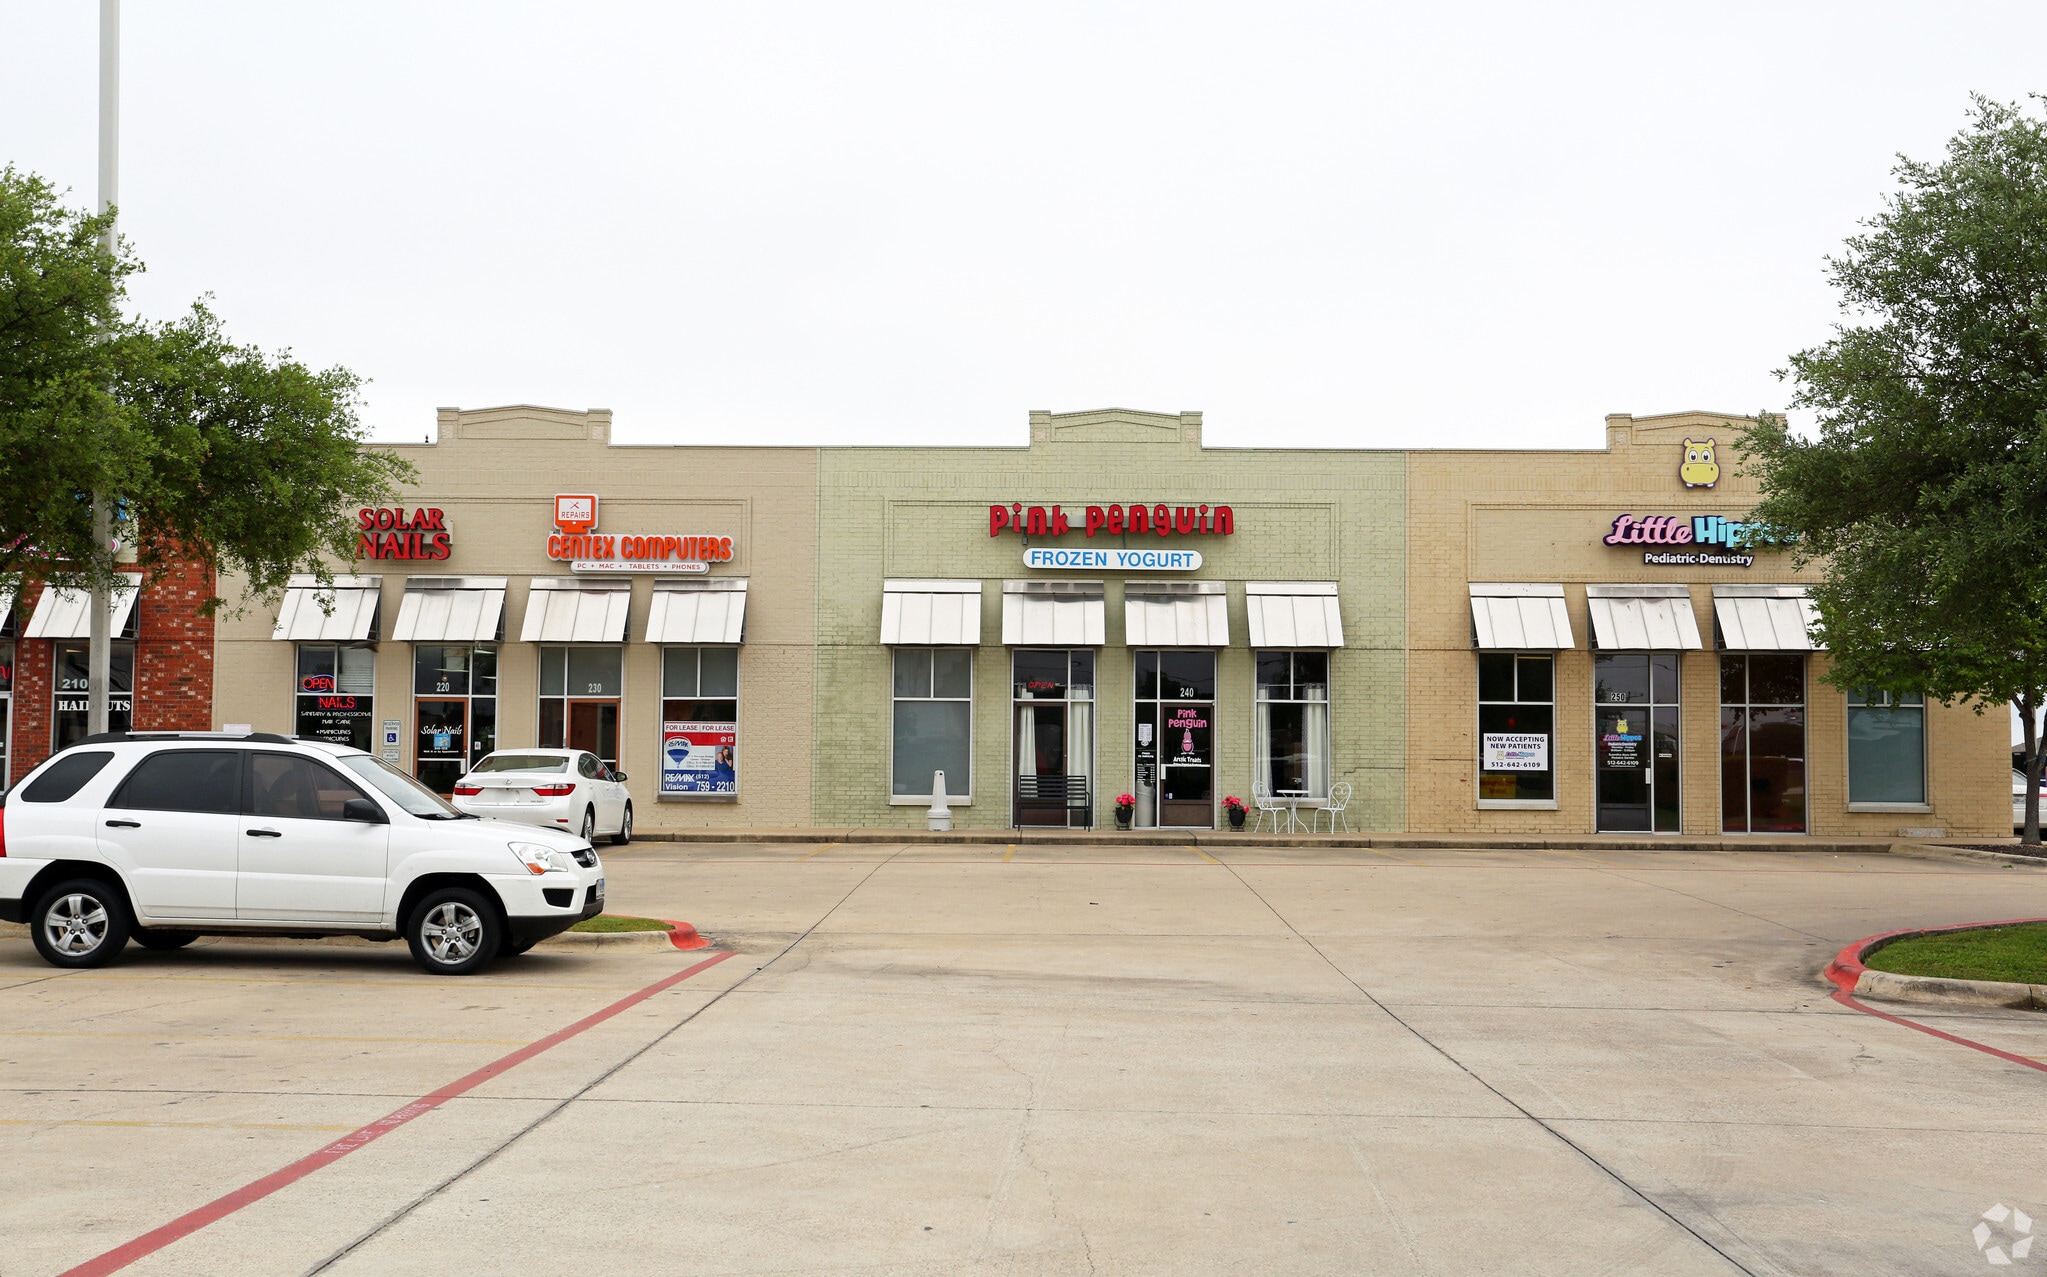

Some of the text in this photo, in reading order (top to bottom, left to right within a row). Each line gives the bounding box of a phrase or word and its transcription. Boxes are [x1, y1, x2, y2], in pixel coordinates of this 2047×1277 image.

[358, 507, 447, 531] SOLAR
[561, 511, 590, 519] REPAIRS
[1605, 514, 1693, 545] Little
[355, 532, 452, 561] NAILS
[547, 535, 733, 561] CENTEX COMPUTERS
[1031, 550, 1195, 568] FROZEN YOGURT
[61, 678, 89, 689] 210
[302, 677, 335, 689] OPEN
[436, 682, 450, 692] 220
[588, 683, 602, 693] 230
[1027, 681, 1055, 689] OPEN
[1180, 687, 1194, 698] 240
[1611, 691, 1626, 701] 250
[319, 696, 356, 709] NAILS
[1177, 709, 1197, 719] Pink
[1168, 718, 1207, 729] Penguin
[420, 724, 463, 735] Solar Nails
[665, 773, 695, 782] RE/MAX
[665, 783, 689, 791] Vision
[696, 781, 710, 792] 759
[716, 781, 735, 792] 2210
